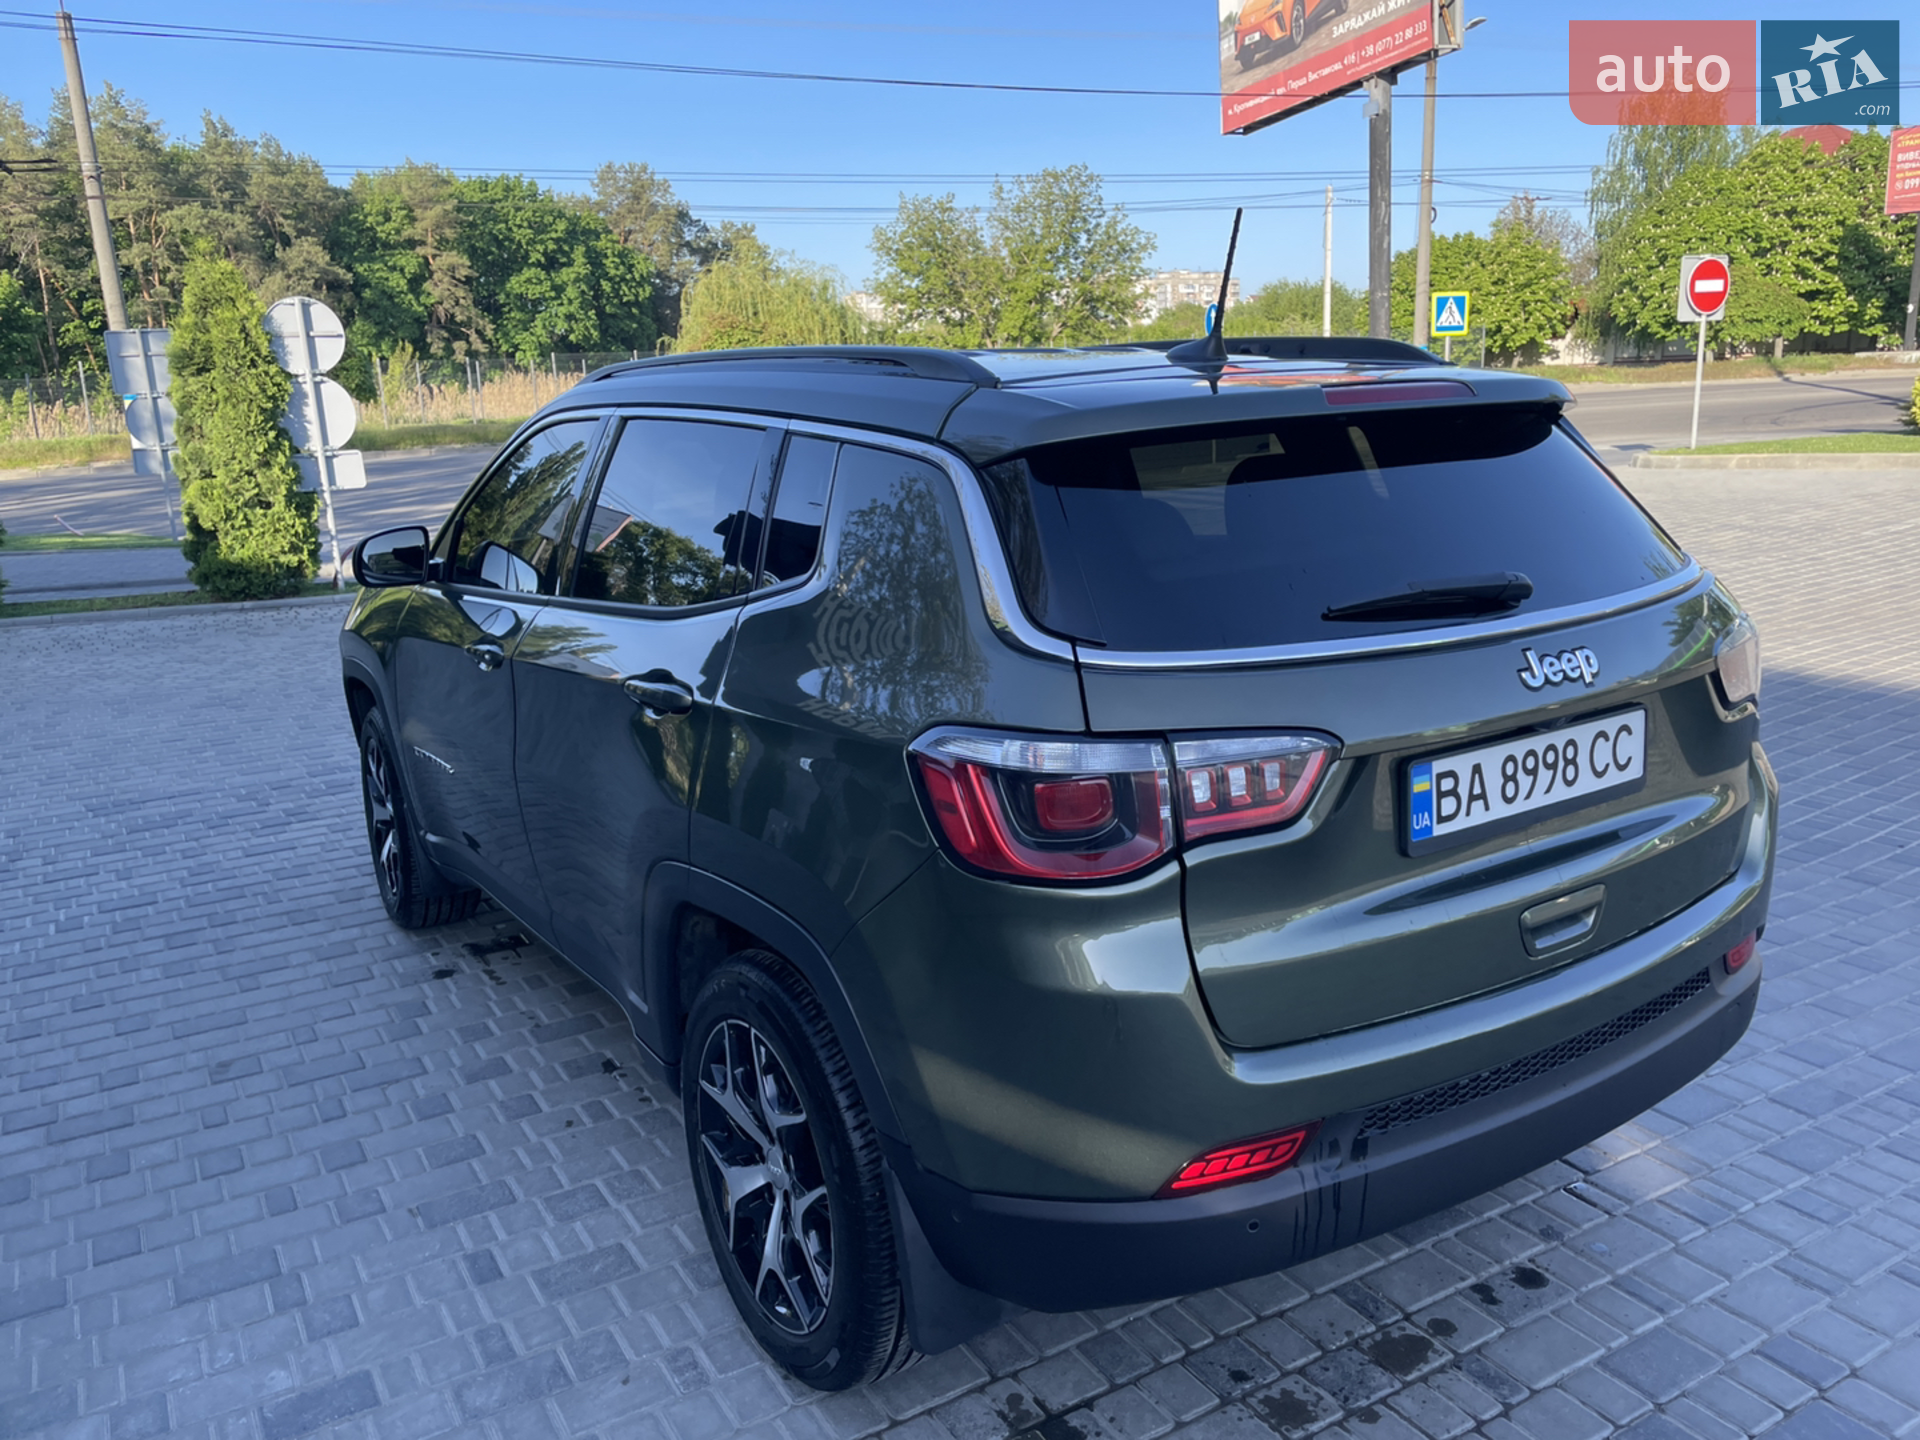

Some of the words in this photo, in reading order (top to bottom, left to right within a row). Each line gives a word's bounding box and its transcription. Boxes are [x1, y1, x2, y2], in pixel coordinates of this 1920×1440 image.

[1332, 2, 1386, 38] ЗАРЯДЖАЙ
[1361, 44, 1374, 57] +38
[1394, 31, 1404, 45] 22
[1414, 20, 1427, 35] 333
[1516, 646, 1600, 691] Jeep
[1435, 762, 1490, 825] BA
[1500, 738, 1579, 805] 8998
[1589, 724, 1633, 779] CC
[1413, 812, 1431, 829] UA
